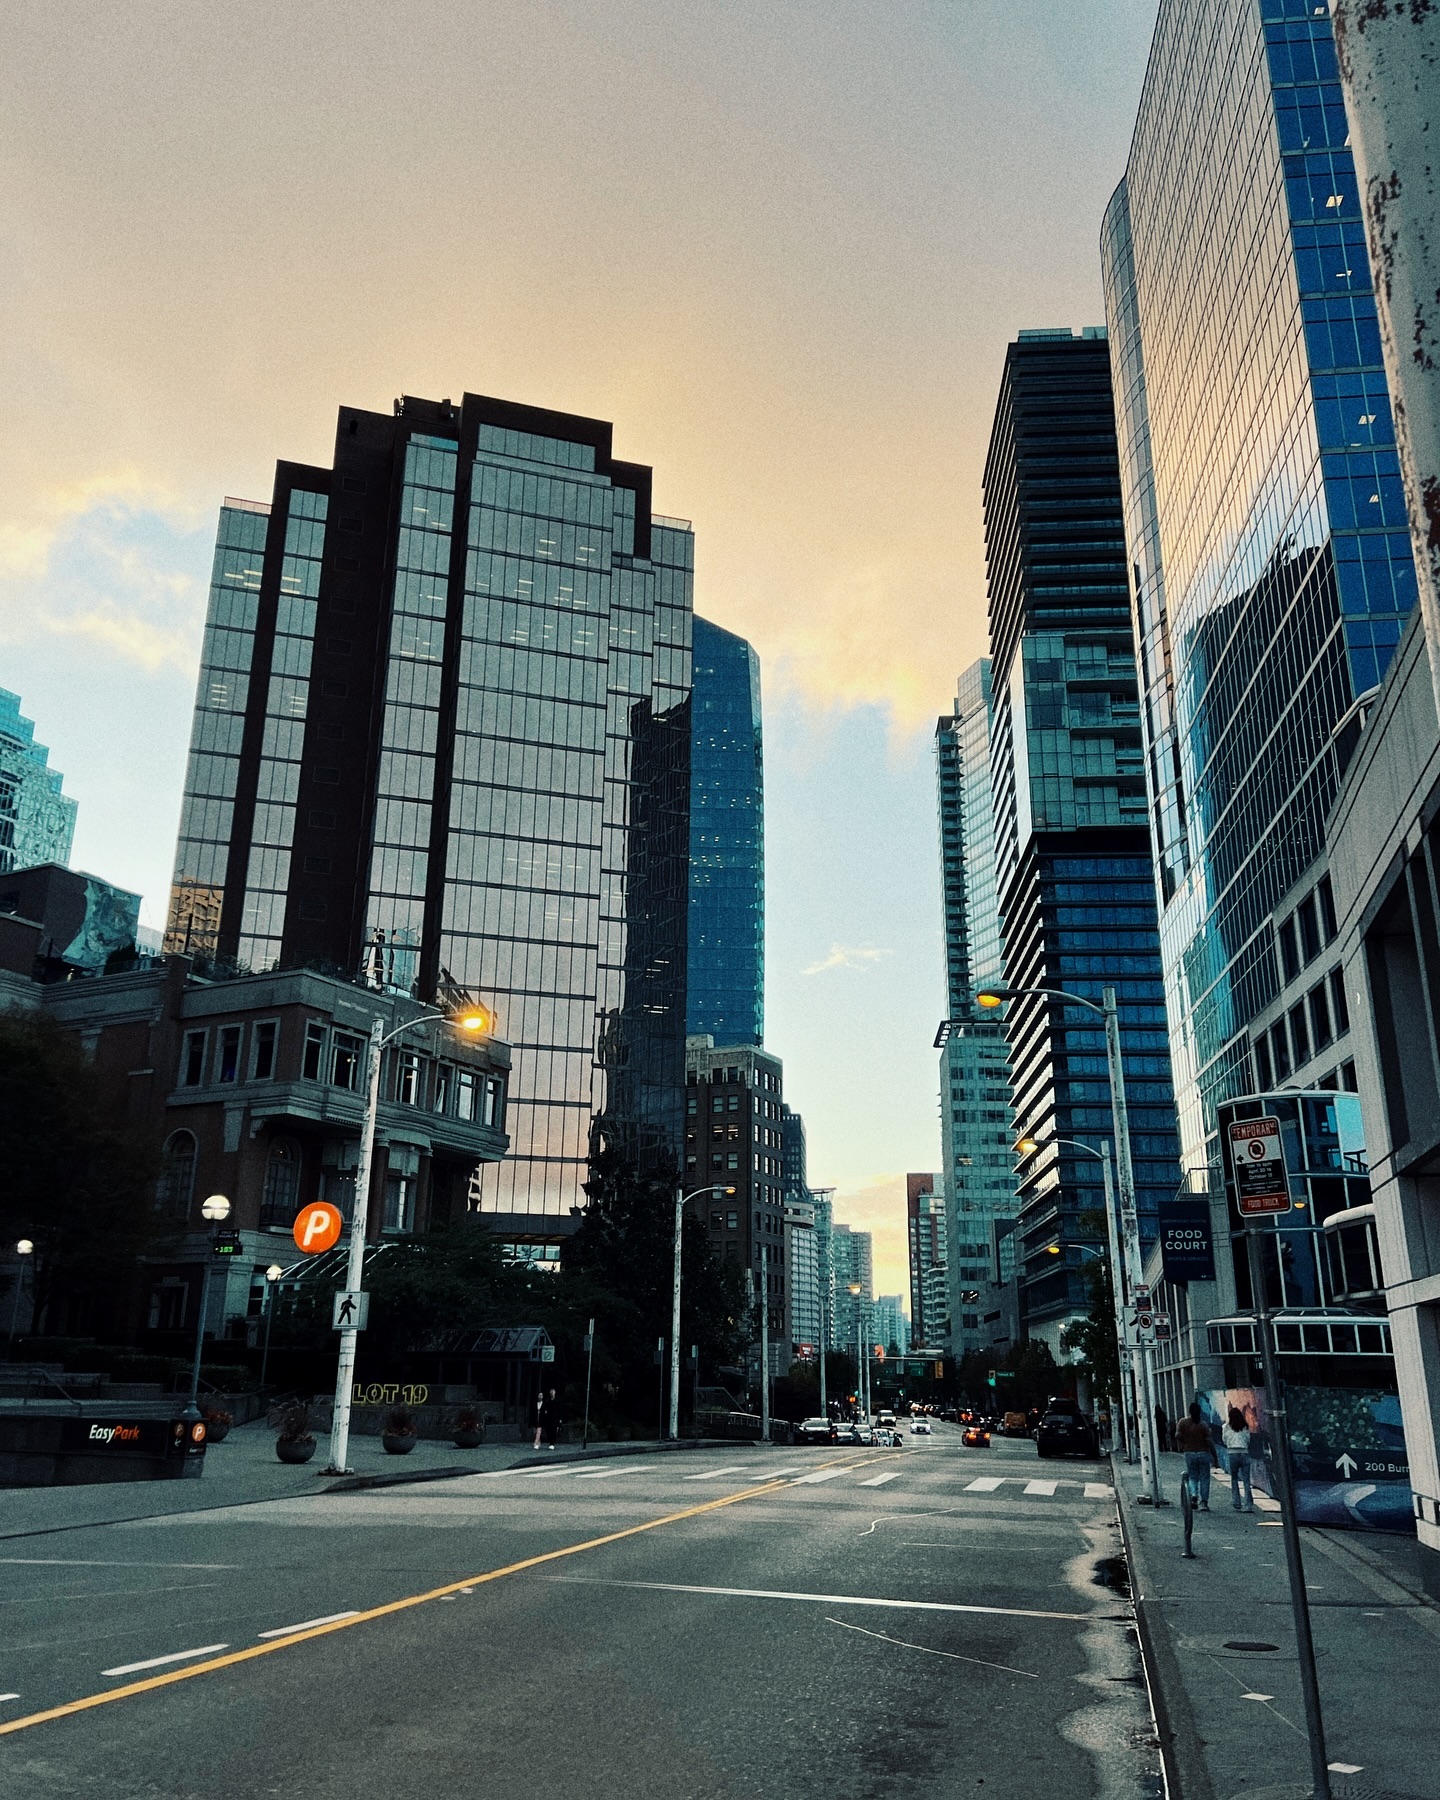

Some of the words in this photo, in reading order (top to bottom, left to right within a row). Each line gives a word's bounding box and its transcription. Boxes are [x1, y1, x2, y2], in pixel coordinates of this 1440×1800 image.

[1232, 1122, 1277, 1139] TEMPORARY
[303, 1210, 330, 1246] P
[1167, 1230, 1203, 1239] FOOD
[1165, 1241, 1208, 1250] COURT
[352, 1383, 399, 1404] LOT
[402, 1384, 428, 1405] 19
[89, 1424, 140, 1443] EasyPark
[193, 1425, 203, 1440] P
[1364, 1462, 1386, 1472] 200
